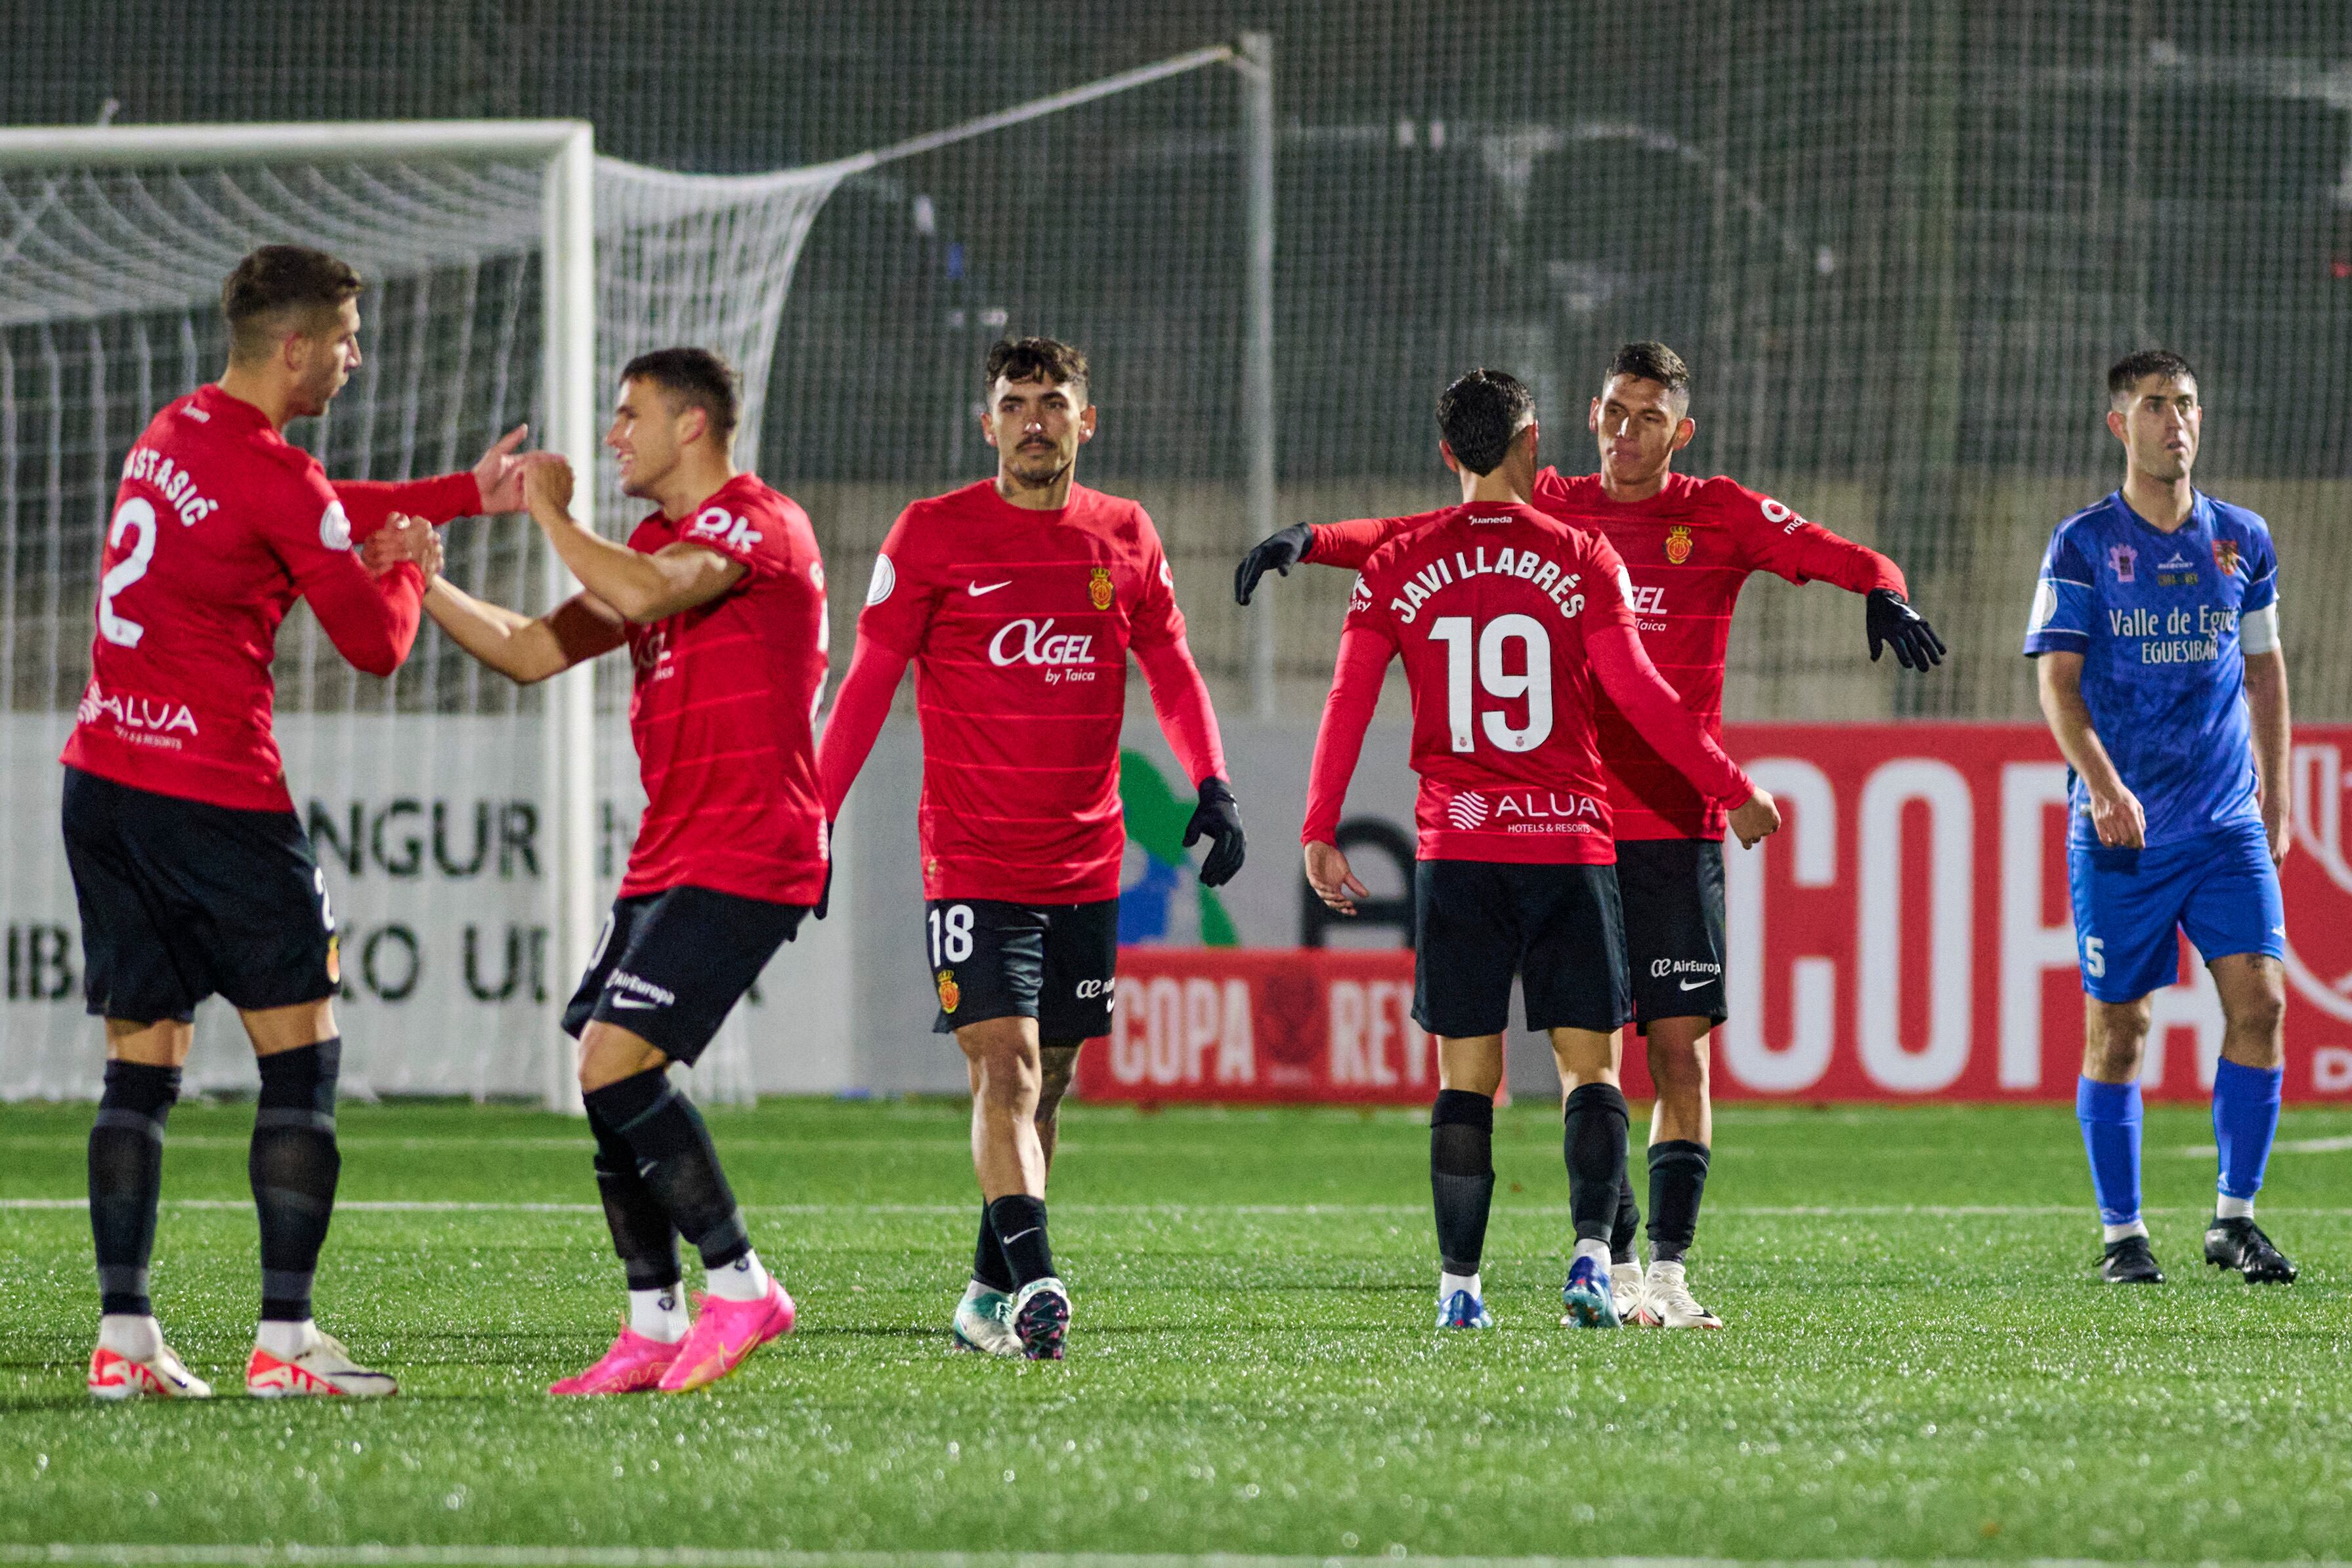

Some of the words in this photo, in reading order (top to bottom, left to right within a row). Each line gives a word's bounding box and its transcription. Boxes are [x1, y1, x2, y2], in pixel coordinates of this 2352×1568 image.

[1468, 515, 1512, 526] juaneda
[99, 497, 157, 648] 2
[1390, 558, 1453, 624] JAVI
[1456, 546, 1585, 619] LLABRÉS
[2109, 608, 2158, 637] Valle
[2167, 606, 2191, 635] de
[2141, 639, 2219, 665] EGUESIBAR
[1045, 668, 1061, 686] by
[1065, 667, 1096, 682] Taica
[1428, 614, 1554, 753] 19
[103, 694, 198, 736] ALUA
[1495, 792, 1600, 819] ALUA
[1508, 824, 1545, 833] HOTELS
[1555, 824, 1591, 834] RESORTS
[929, 904, 974, 967] 18
[1673, 960, 1721, 975] AirEurop
[2085, 936, 2106, 979] 5
[1110, 977, 1256, 1084] COPA
